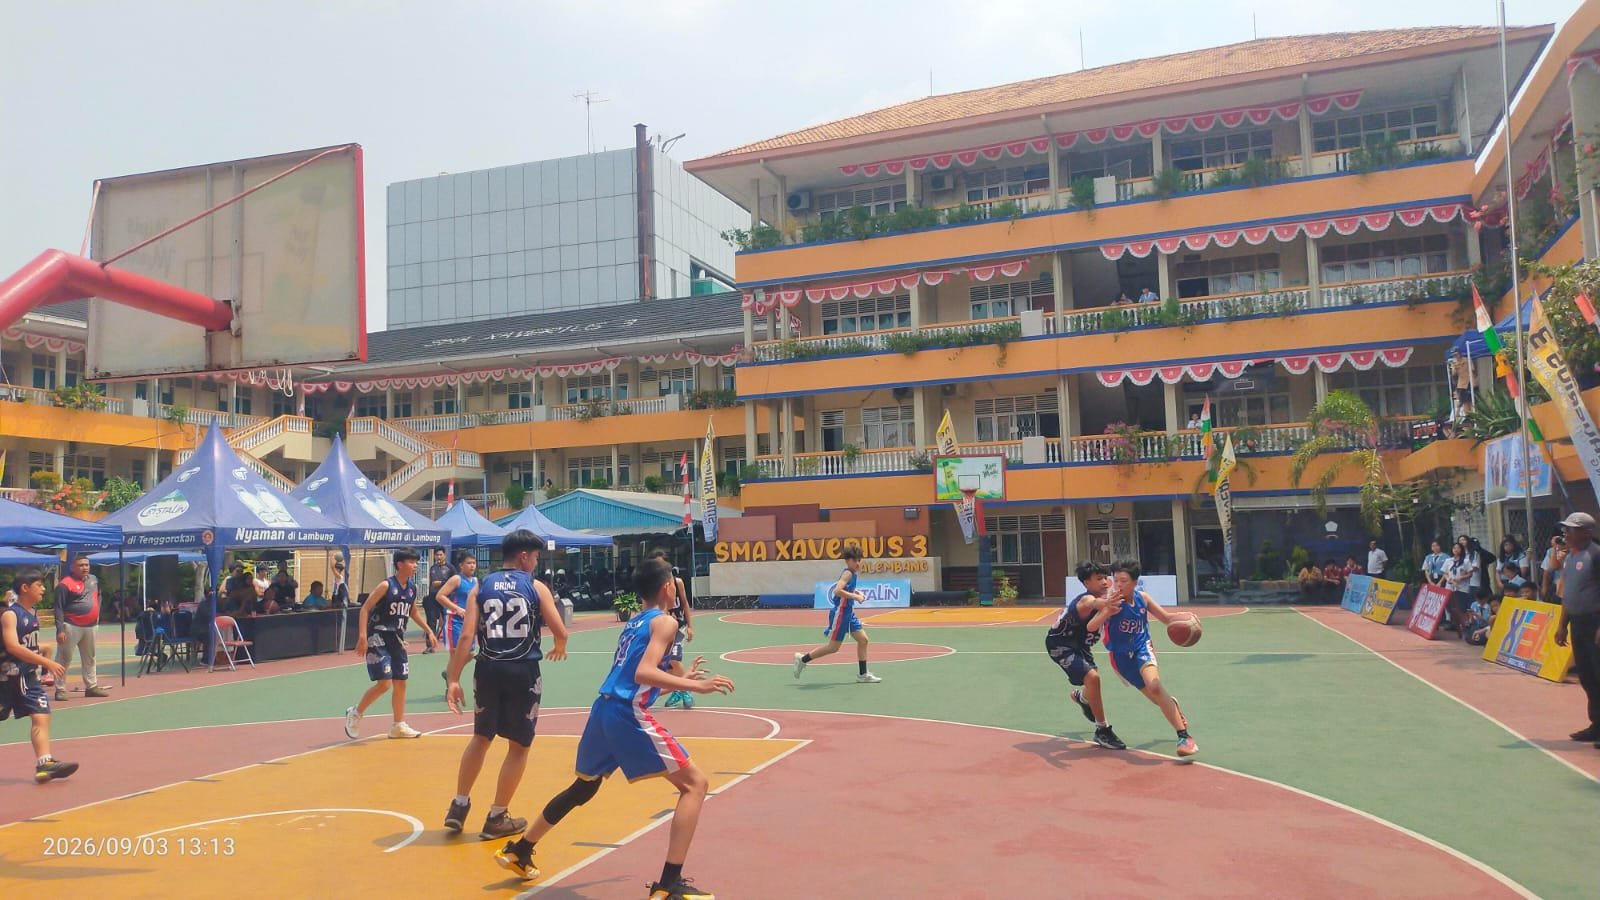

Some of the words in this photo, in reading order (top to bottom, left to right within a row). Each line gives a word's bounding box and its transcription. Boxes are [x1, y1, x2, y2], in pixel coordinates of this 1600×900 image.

[139, 533, 196, 548] Tenggorokan
[235, 528, 285, 543] Nyaman
[287, 530, 297, 542] di
[297, 531, 335, 543] Lambung
[363, 529, 403, 544] Nyaman
[404, 533, 411, 542] di
[412, 532, 441, 544] Lambung
[714, 540, 767, 563] SMA
[910, 534, 928, 558] 3
[484, 598, 529, 639] 22
